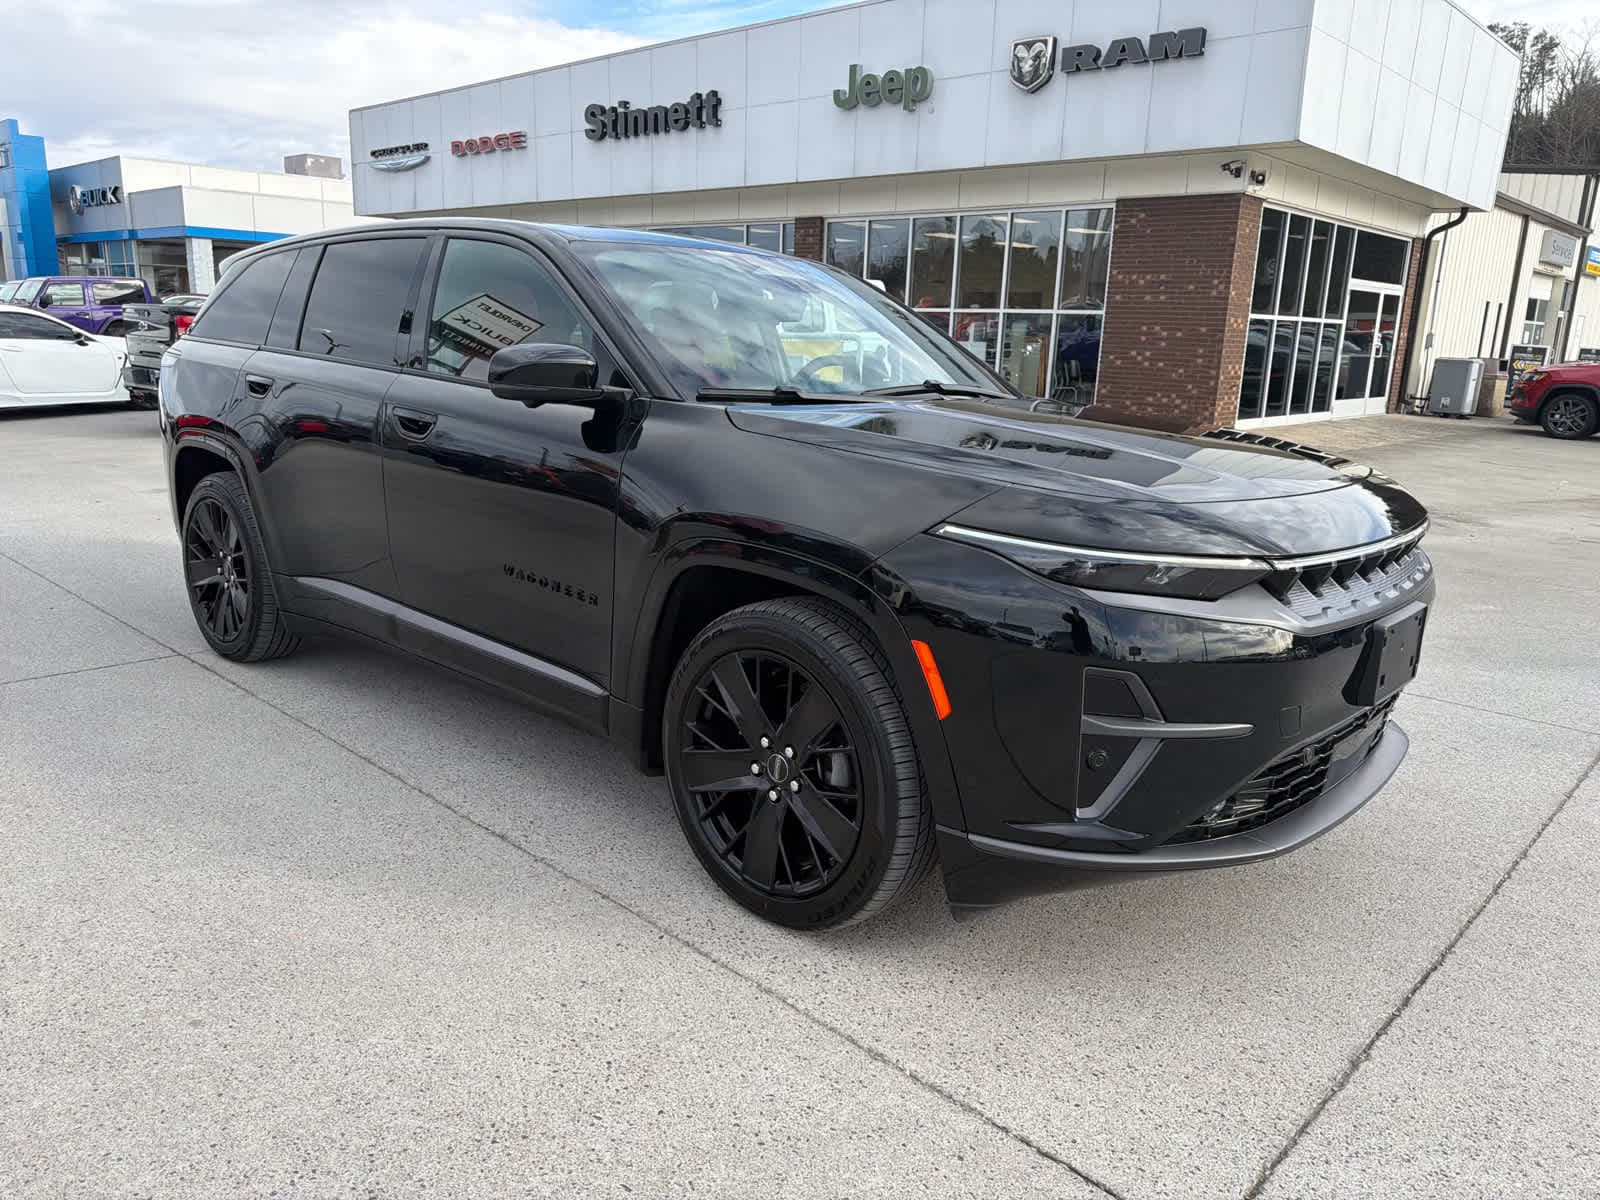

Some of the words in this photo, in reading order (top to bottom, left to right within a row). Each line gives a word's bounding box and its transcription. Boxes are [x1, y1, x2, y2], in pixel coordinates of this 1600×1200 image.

[1061, 27, 1207, 73] RAM
[833, 63, 933, 112] Jeep
[584, 90, 722, 141] Stinnett
[451, 131, 527, 157] DODGE
[80, 185, 121, 208] BUICK
[503, 562, 598, 606] WAGONEER
